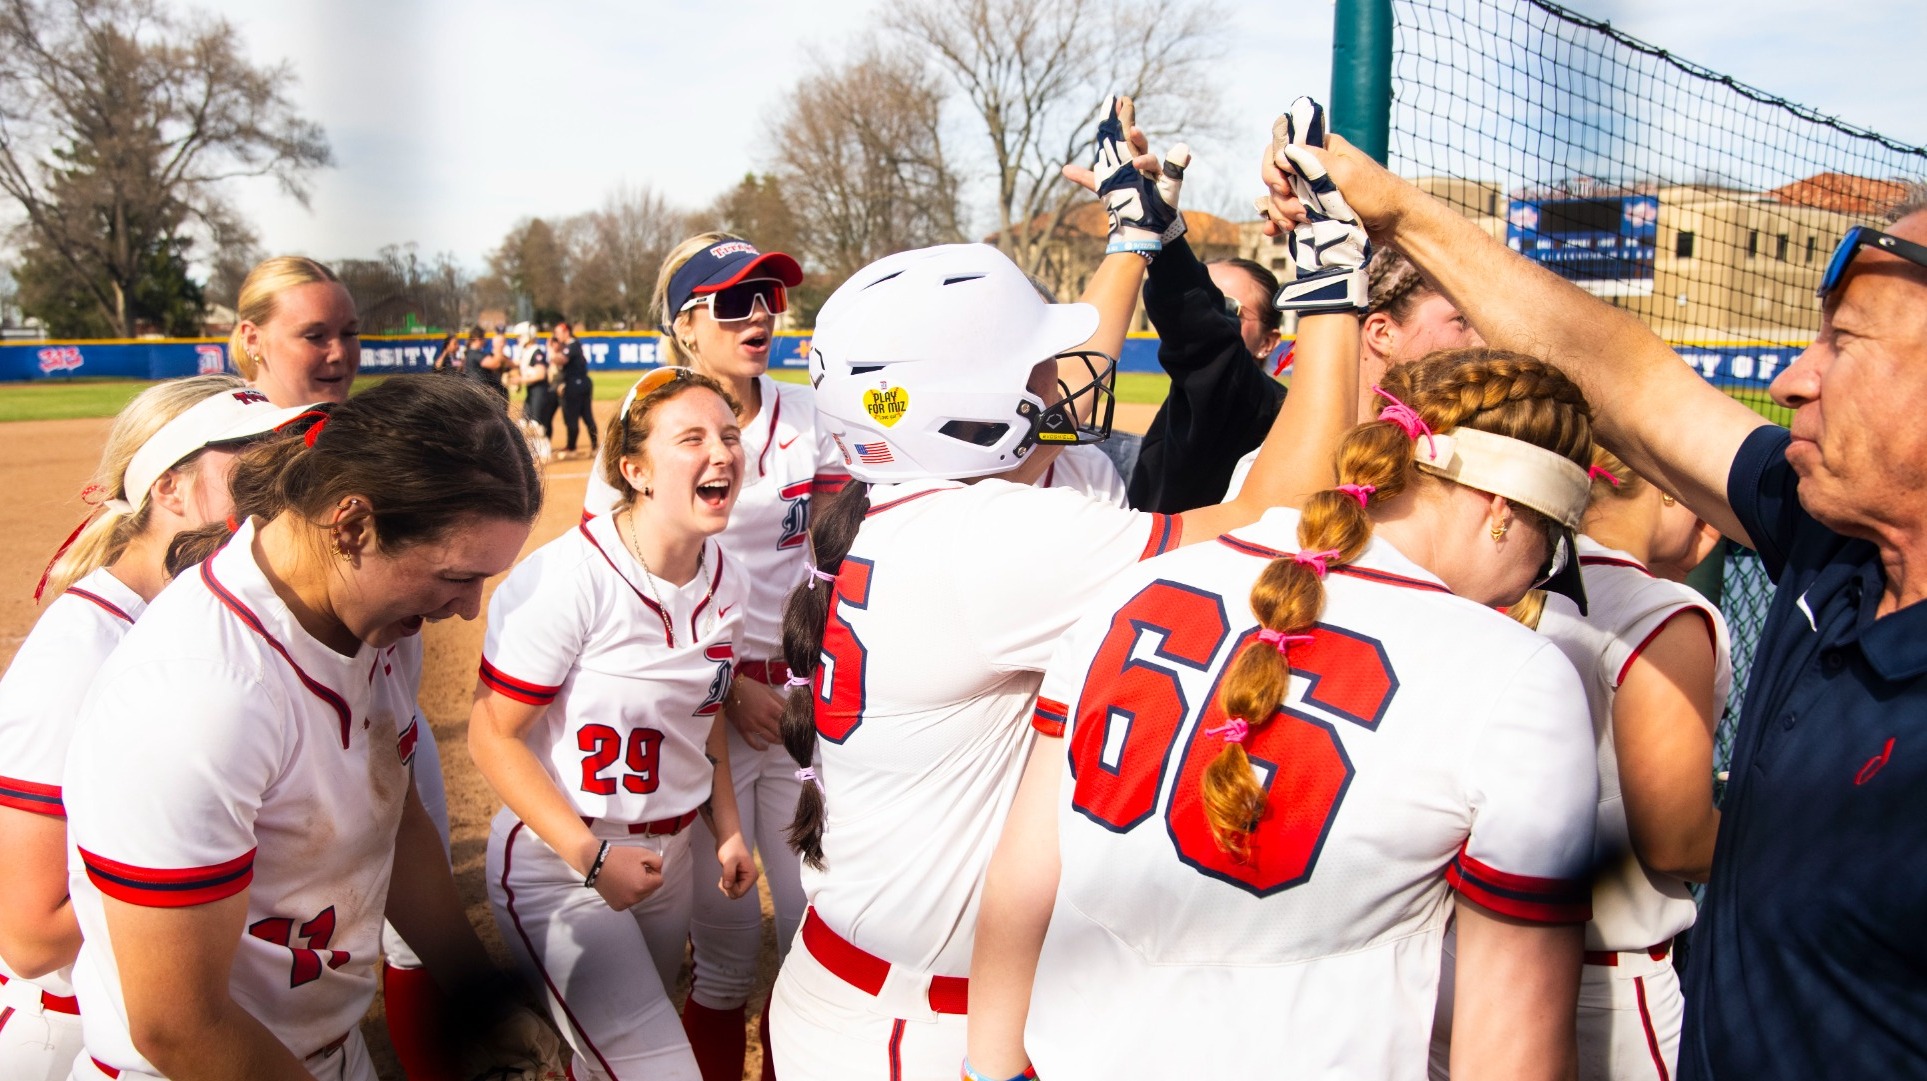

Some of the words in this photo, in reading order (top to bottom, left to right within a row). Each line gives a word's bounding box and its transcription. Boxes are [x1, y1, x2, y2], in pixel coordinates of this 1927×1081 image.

[867, 402, 886, 415] FOR
[887, 401, 907, 414] MIZ
[873, 391, 897, 404] PLAY
[577, 723, 665, 796] 29
[1067, 578, 1401, 899] 66
